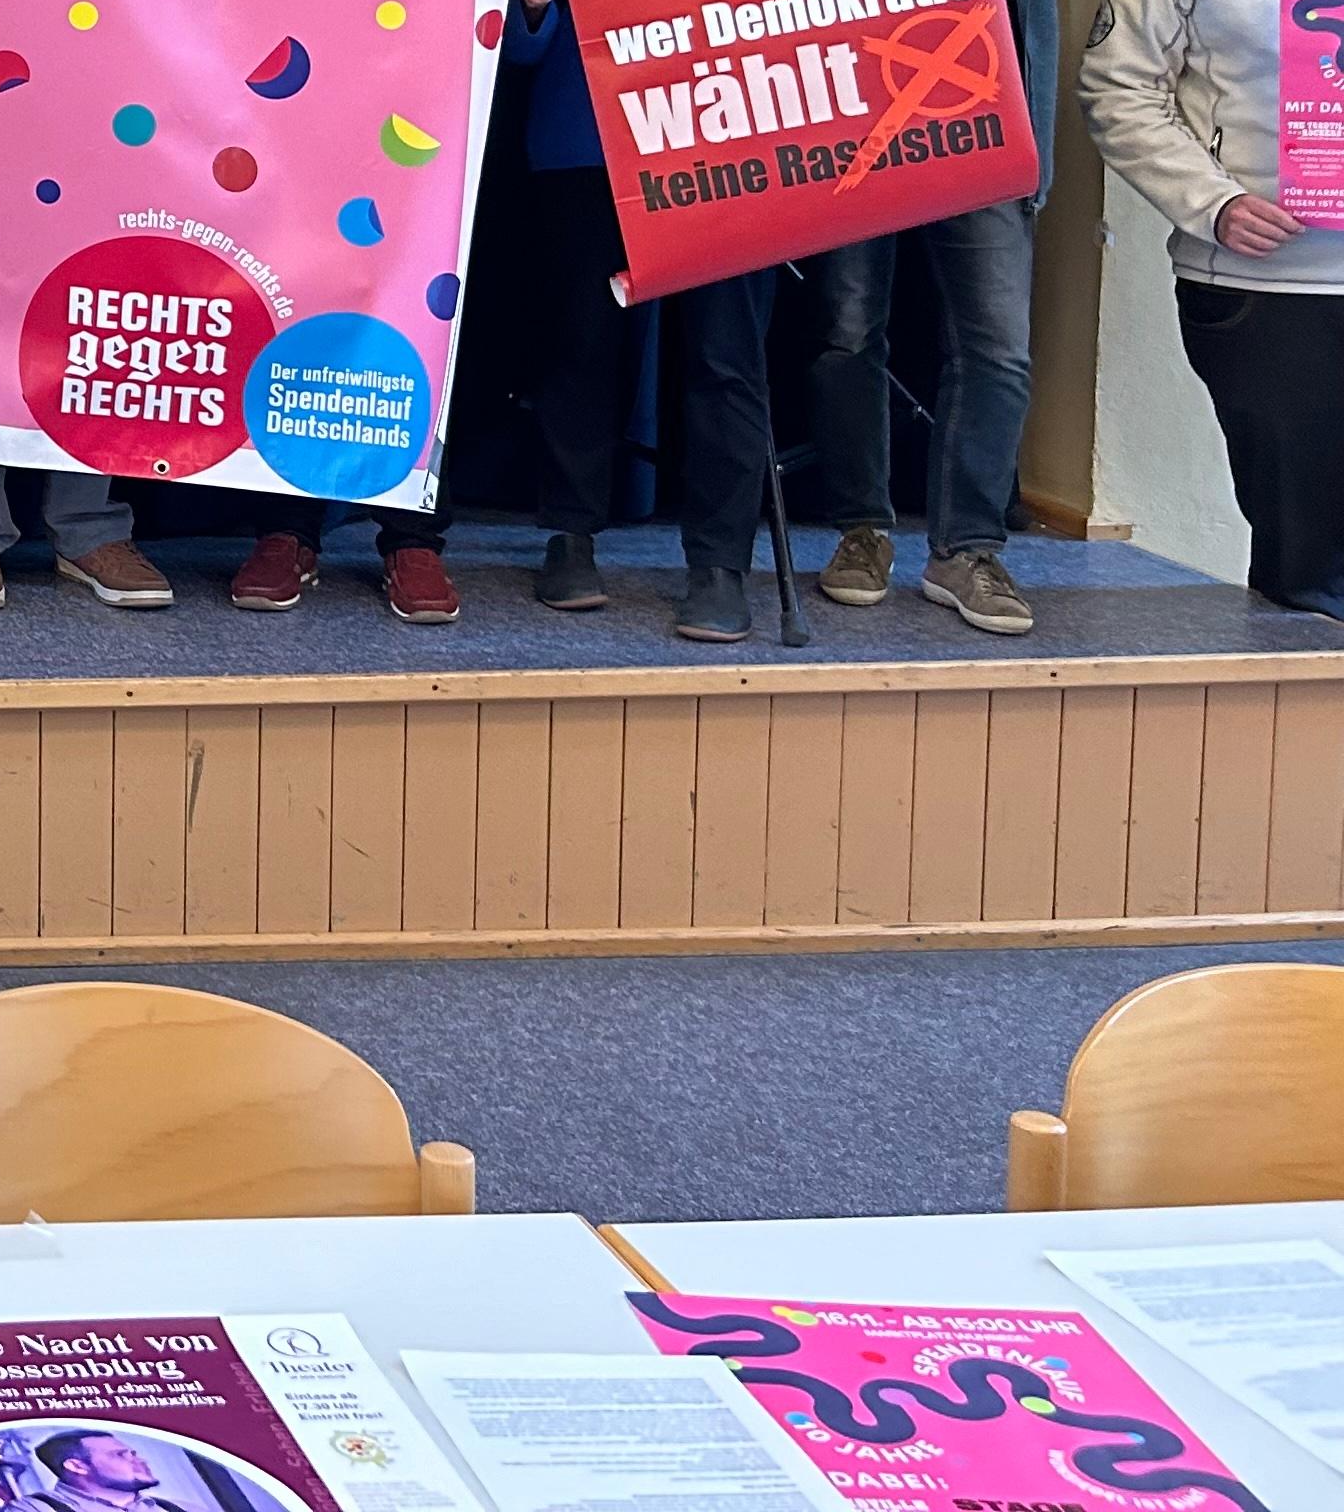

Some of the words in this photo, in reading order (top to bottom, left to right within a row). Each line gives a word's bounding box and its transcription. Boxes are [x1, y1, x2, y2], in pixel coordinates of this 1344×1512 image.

[605, 12, 694, 66] wer
[618, 42, 868, 156] wählt
[1285, 102, 1314, 112] MIT
[638, 158, 768, 213] keine
[1284, 187, 1303, 196] FÜR
[118, 207, 294, 320] rechts-gegen-rechts.de
[68, 286, 232, 338] RECHTS
[65, 330, 228, 383] gegen
[270, 363, 298, 381] Der
[302, 367, 415, 393] unfreiwilligste
[60, 377, 225, 427] RECHTS
[268, 383, 412, 421] Spendenlauf
[266, 410, 410, 449] Deutschlands
[815, 1311, 883, 1328] 16.11.
[902, 1315, 941, 1329] AB
[942, 1317, 1016, 1332] 15:00
[1017, 1320, 1083, 1335] UHR
[15, 1332, 132, 1356] Nacht
[144, 1333, 218, 1352] von
[264, 1361, 355, 1374] Theater
[913, 1342, 1085, 1403] SPENDENLAUF
[59, 1383, 100, 1396] dem
[166, 1380, 204, 1393] und
[793, 1421, 831, 1443] 10
[834, 1439, 944, 1464] JAHRE
[827, 1471, 949, 1491] DABEI:
